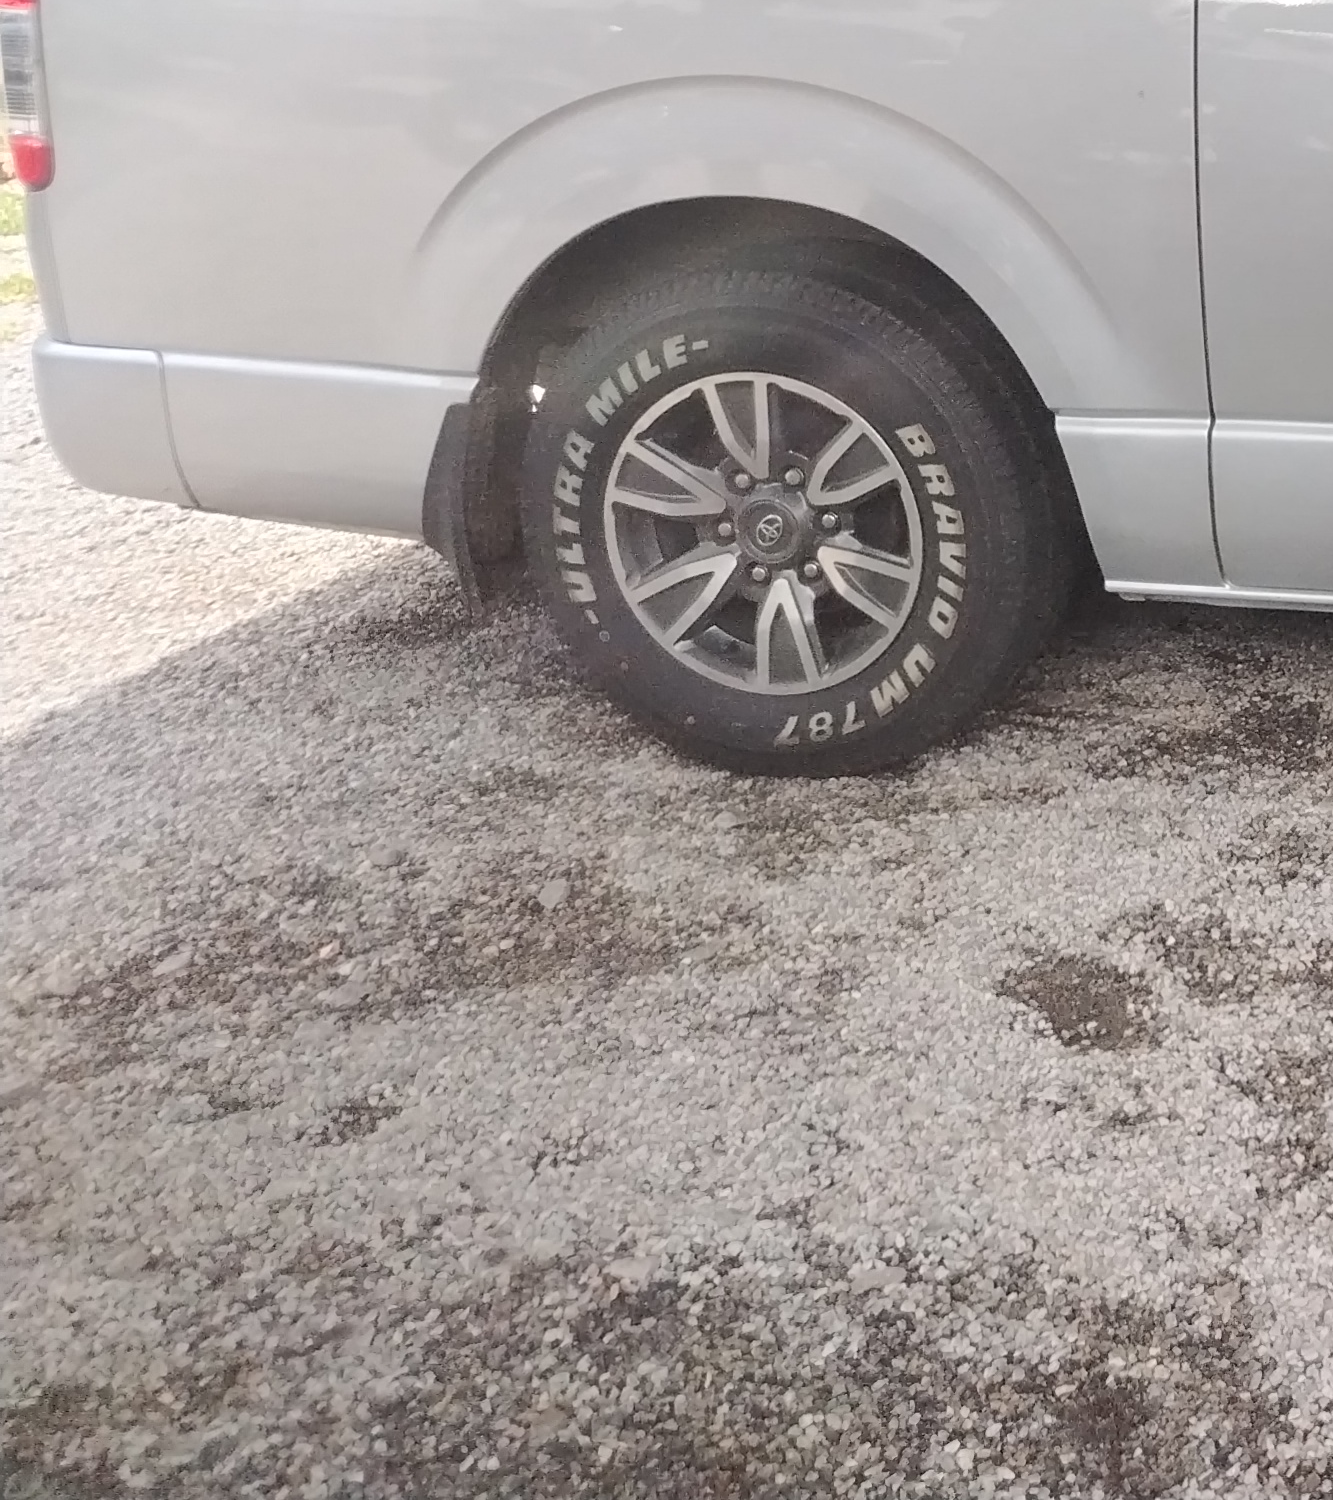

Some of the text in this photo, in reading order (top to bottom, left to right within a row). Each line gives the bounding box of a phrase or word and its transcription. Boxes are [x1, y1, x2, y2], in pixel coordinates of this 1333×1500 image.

[773, 423, 967, 747] BRAVIO UM 787
